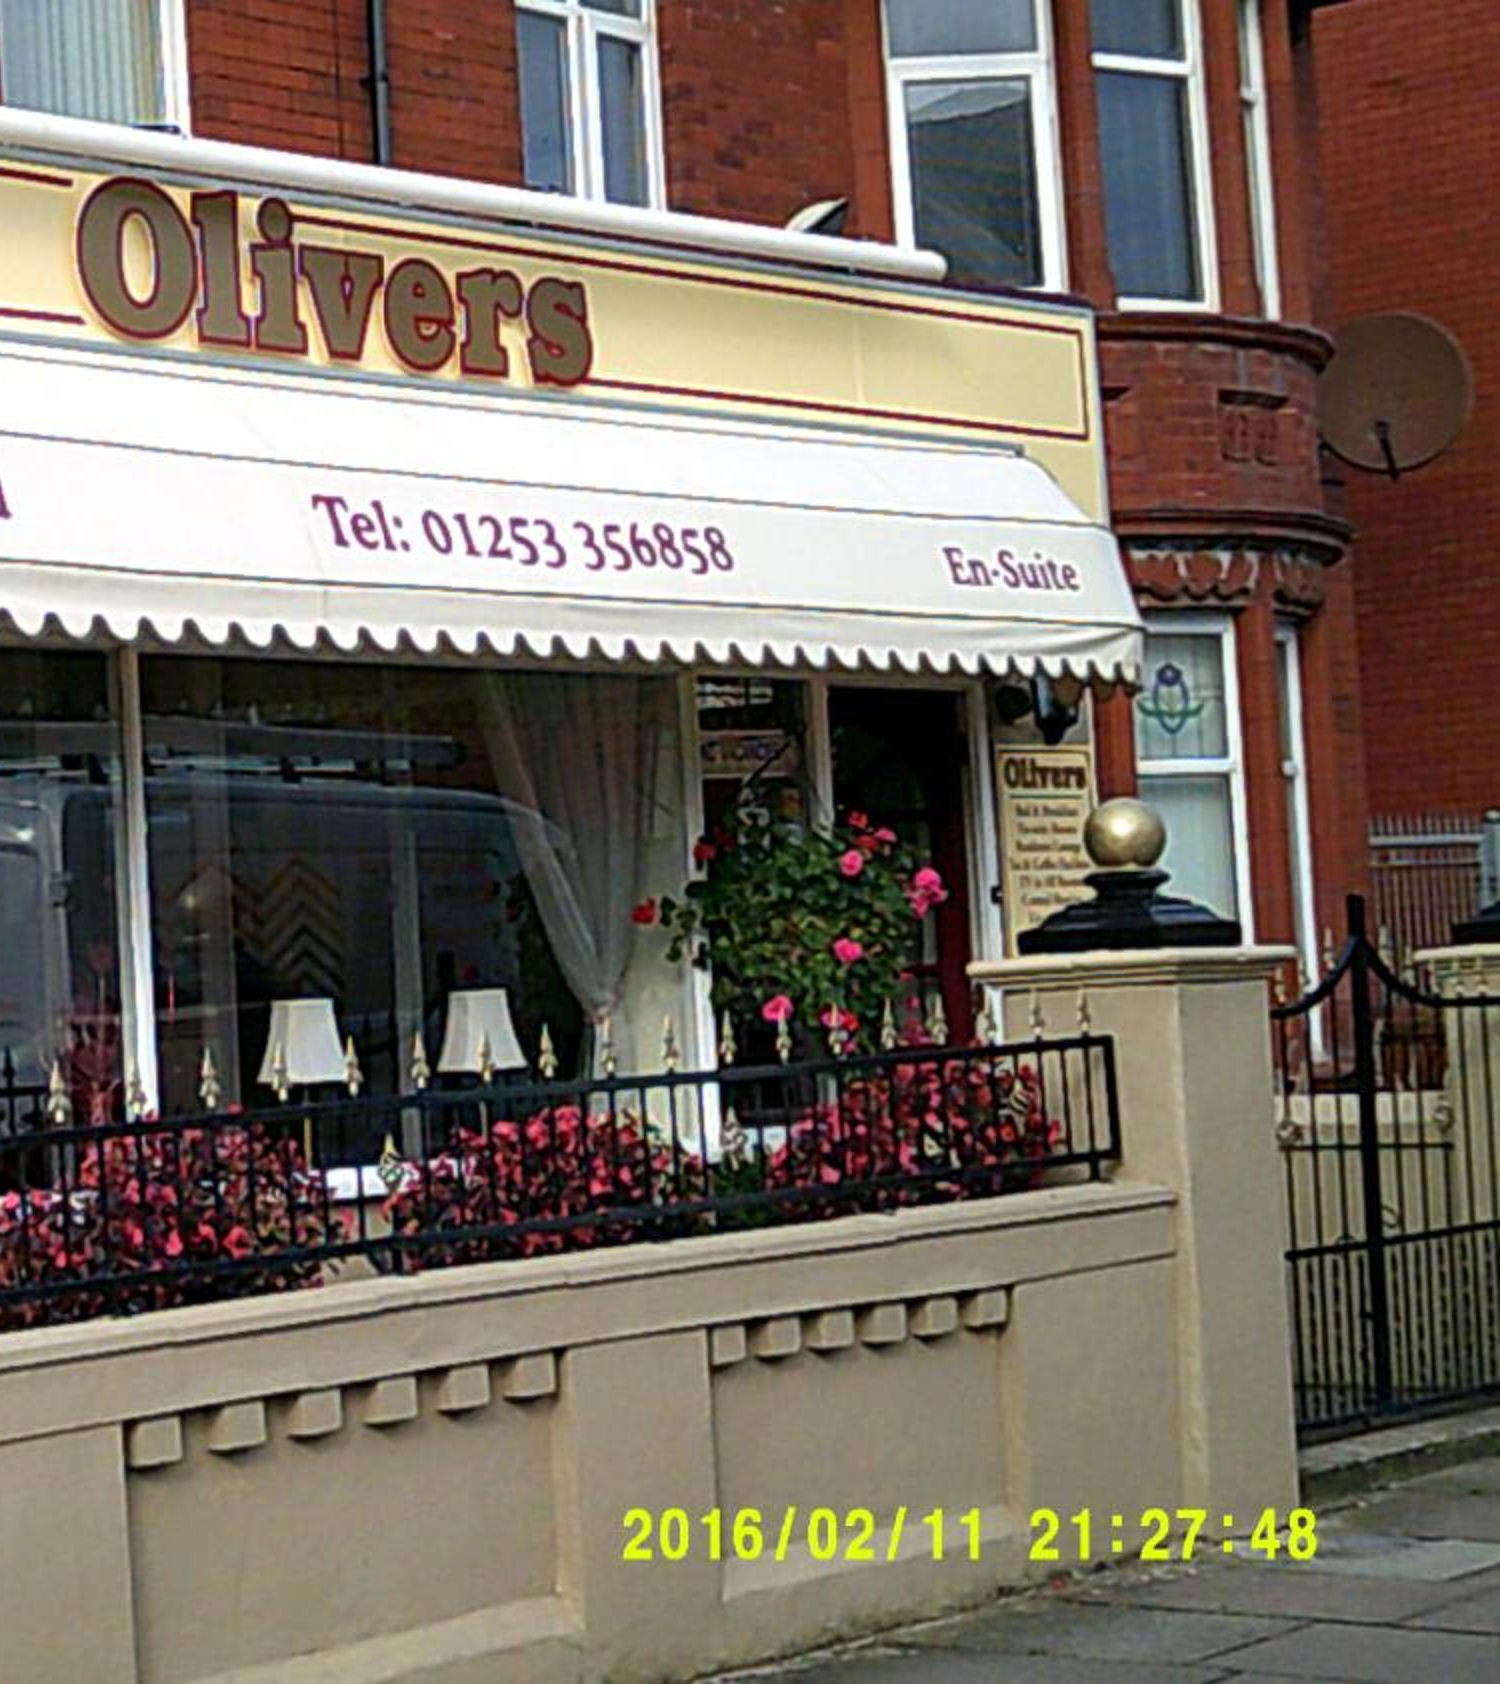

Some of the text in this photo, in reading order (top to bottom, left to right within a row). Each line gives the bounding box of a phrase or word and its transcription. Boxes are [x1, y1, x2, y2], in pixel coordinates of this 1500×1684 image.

[77, 176, 594, 387] Olivers
[311, 494, 734, 575] Tel: 01253 356858
[942, 546, 1081, 591] En-Suite
[1003, 757, 1087, 789] Olivers
